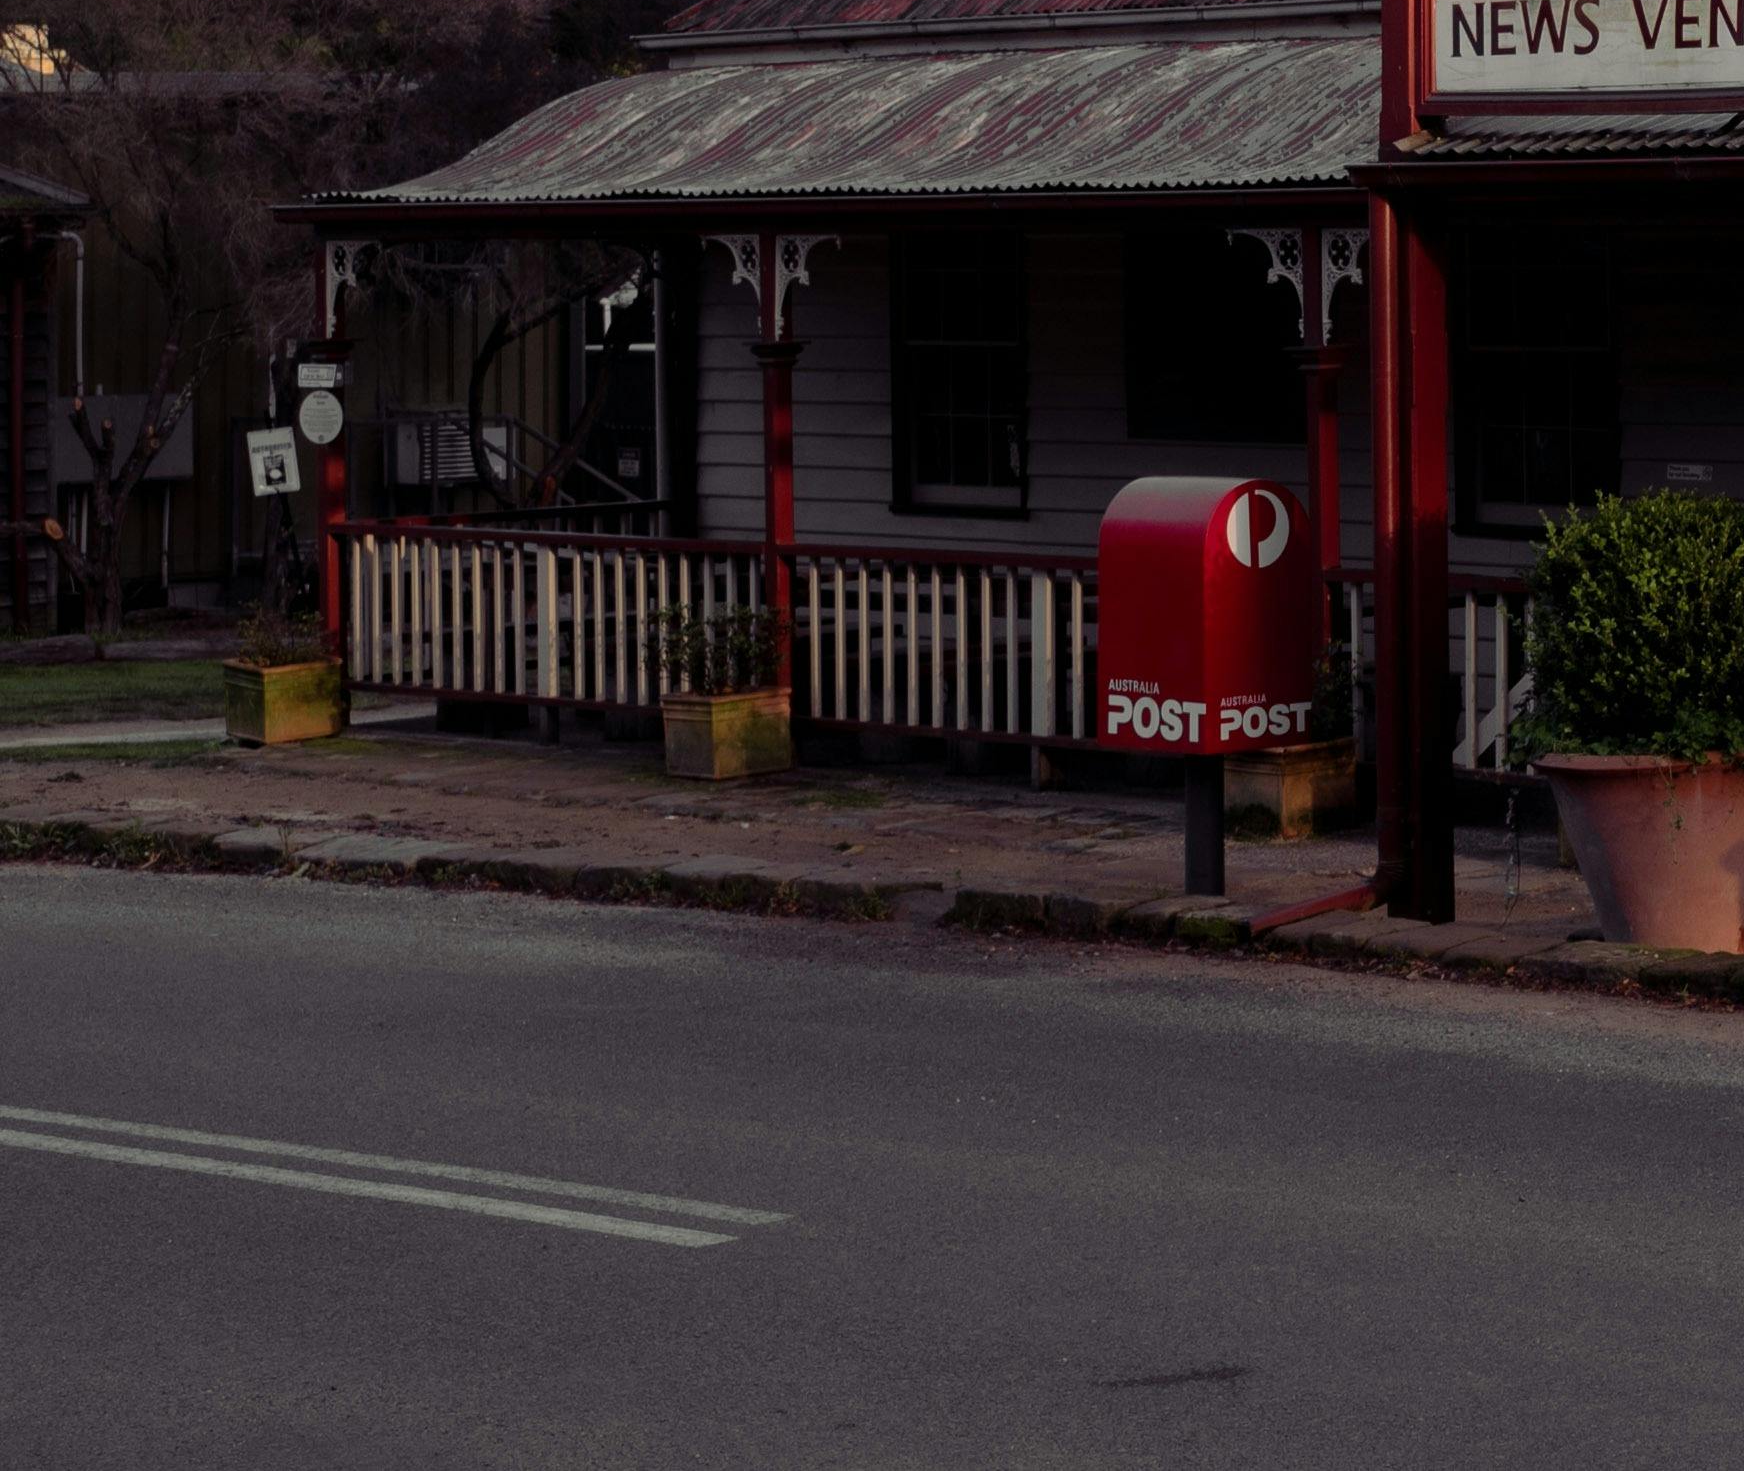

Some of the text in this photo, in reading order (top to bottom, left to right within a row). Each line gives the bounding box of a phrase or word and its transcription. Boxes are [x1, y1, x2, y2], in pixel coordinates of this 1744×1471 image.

[1108, 678, 1160, 695] AUSTRALIA
[1220, 693, 1267, 708] AUSTRALIA
[1107, 694, 1207, 743] POST
[1219, 701, 1312, 742] POST
